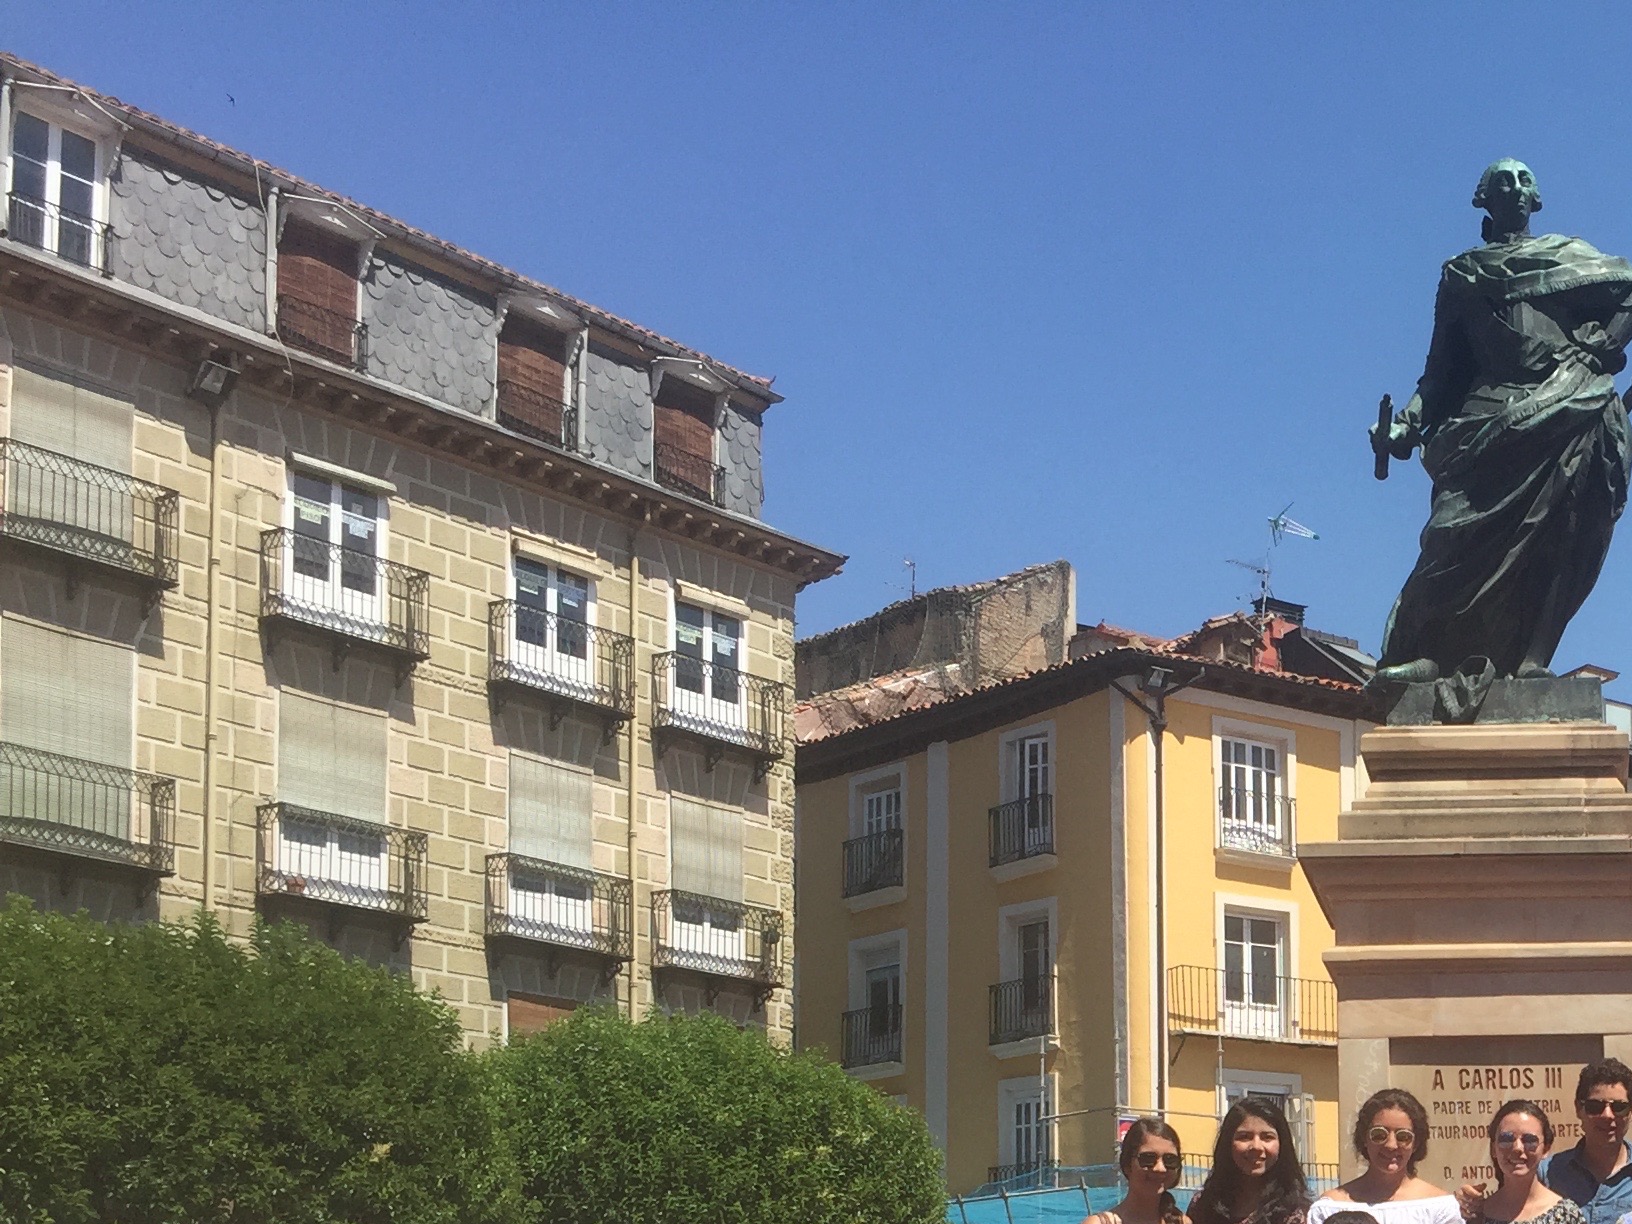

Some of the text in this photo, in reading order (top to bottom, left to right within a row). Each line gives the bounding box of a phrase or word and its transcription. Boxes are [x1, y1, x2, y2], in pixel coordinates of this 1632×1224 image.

[1432, 1067, 1562, 1090] A CARLOS III
[1433, 1100, 1471, 1115] PADRE
[1478, 1100, 1493, 1114] DE
[1533, 1099, 1562, 1113] TRIA
[1429, 1125, 1490, 1139] TAURADO
[1461, 1165, 1493, 1179] ANTO
